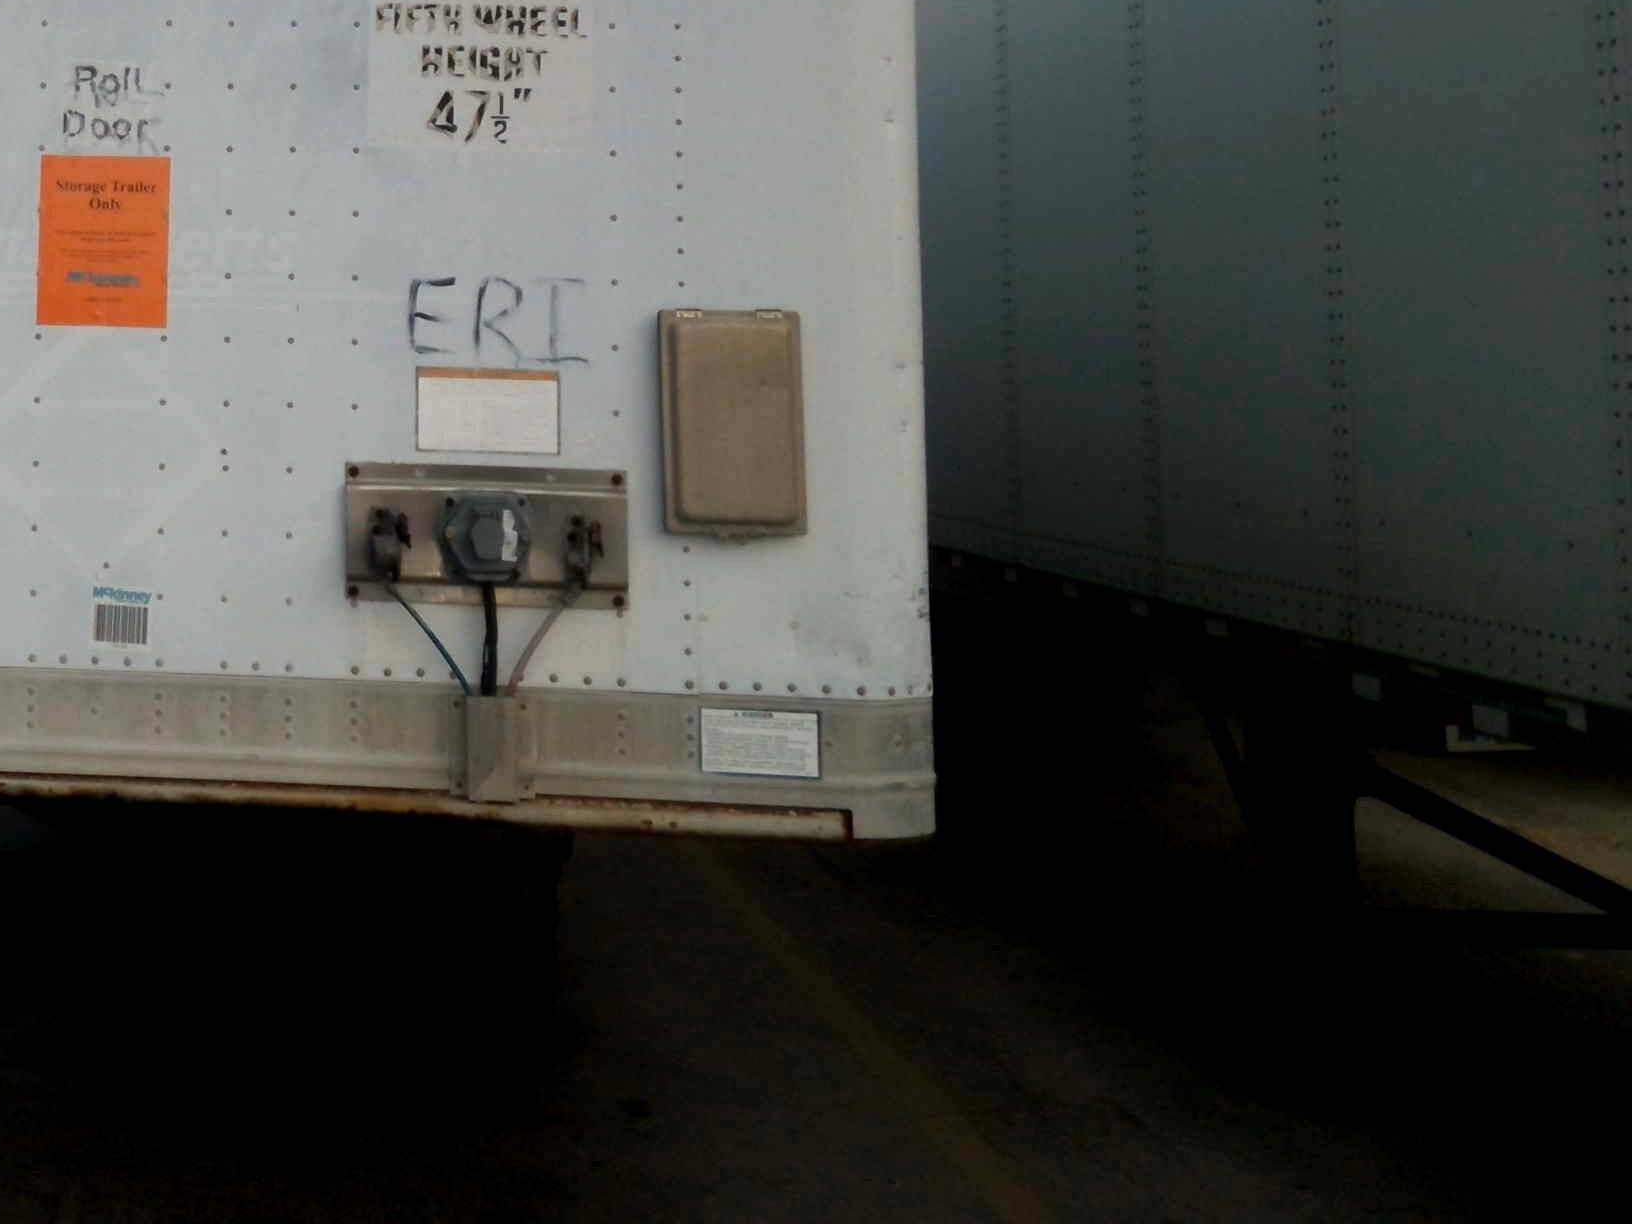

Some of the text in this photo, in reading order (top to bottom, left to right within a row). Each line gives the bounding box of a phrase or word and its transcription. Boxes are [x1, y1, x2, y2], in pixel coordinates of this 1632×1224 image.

[472, 3, 588, 39] WHEEL
[420, 43, 549, 82] HEIGHT
[74, 64, 145, 95] Roll
[63, 109, 149, 141] Door
[55, 177, 158, 194] Storage Trailer
[88, 197, 123, 212] Only
[407, 276, 589, 368] ERI
